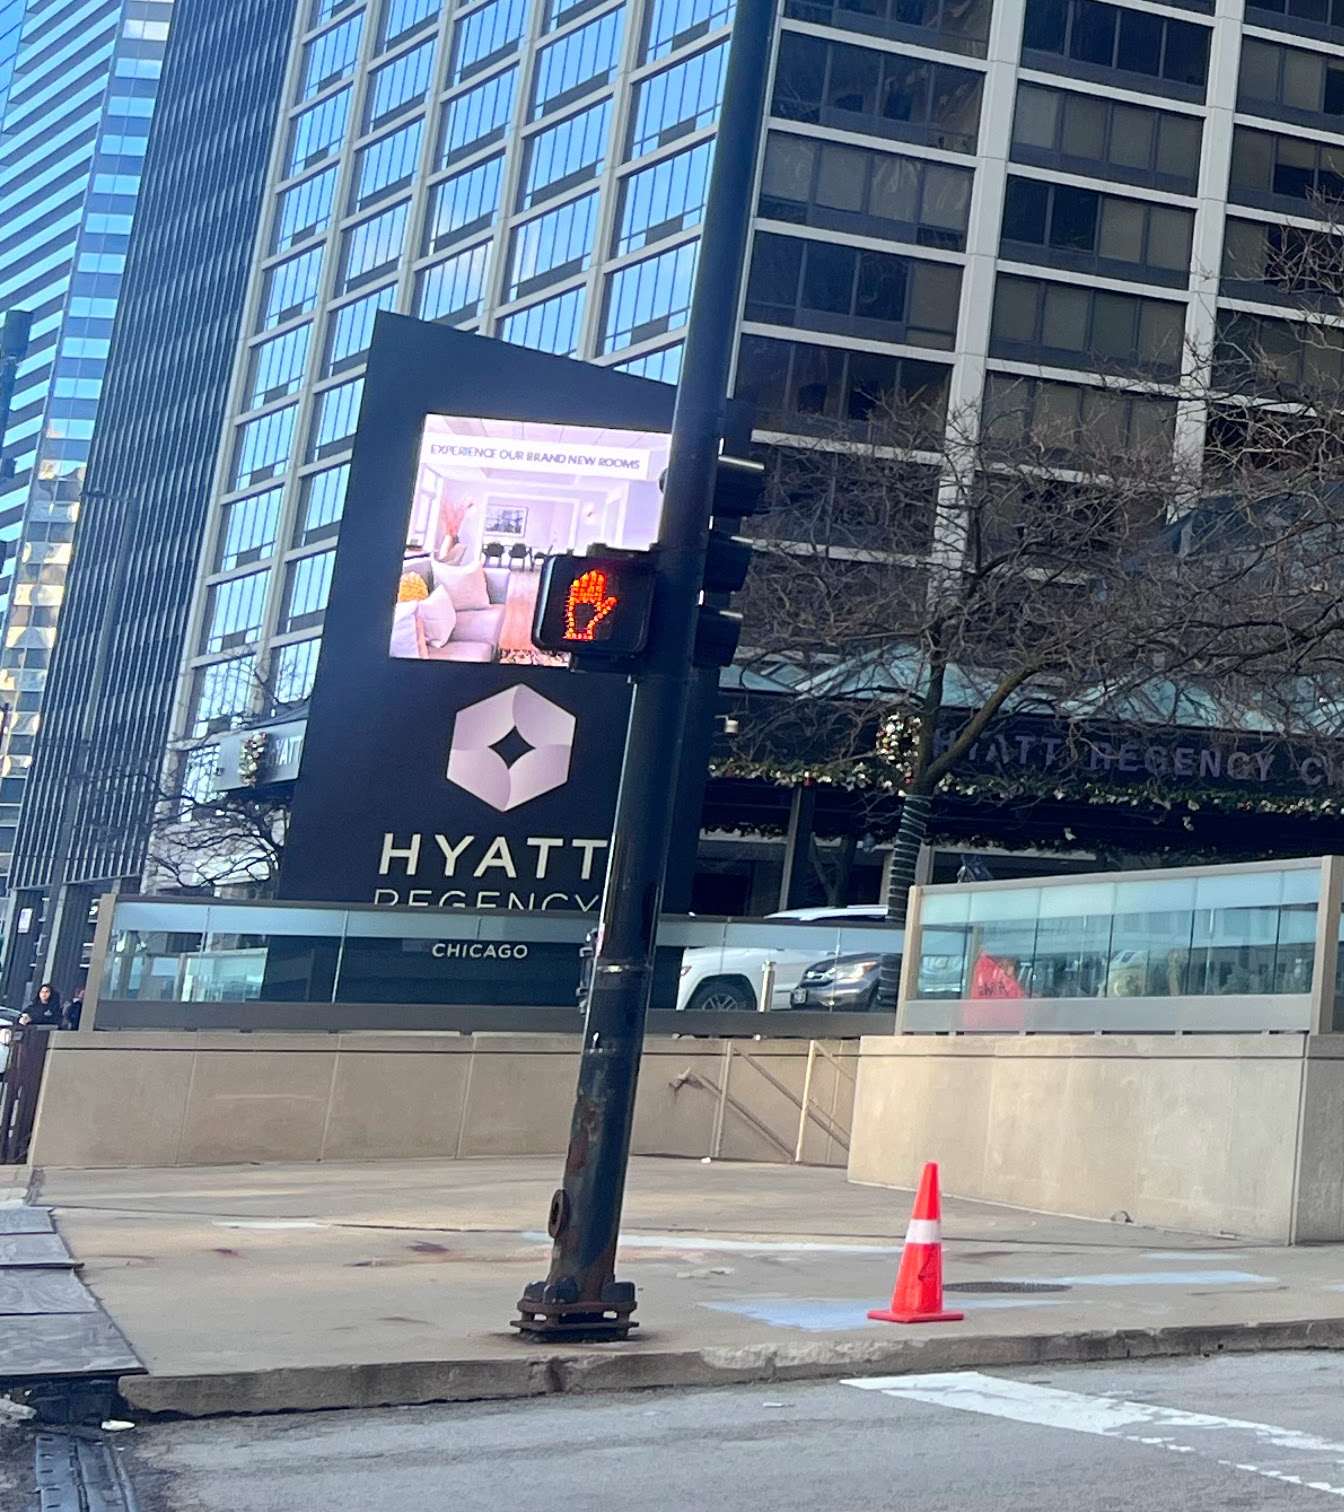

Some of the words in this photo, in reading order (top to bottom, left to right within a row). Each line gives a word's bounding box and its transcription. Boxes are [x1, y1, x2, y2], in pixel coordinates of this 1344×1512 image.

[431, 444, 496, 459] EXPERIENCE
[500, 449, 524, 461] OUR
[527, 452, 566, 464] BRAND
[568, 455, 596, 467] NEW
[598, 457, 640, 470] ROOMS
[1090, 741, 1276, 782] REGENCY
[378, 832, 609, 881] HYATT
[431, 943, 528, 959] CHICAGO
